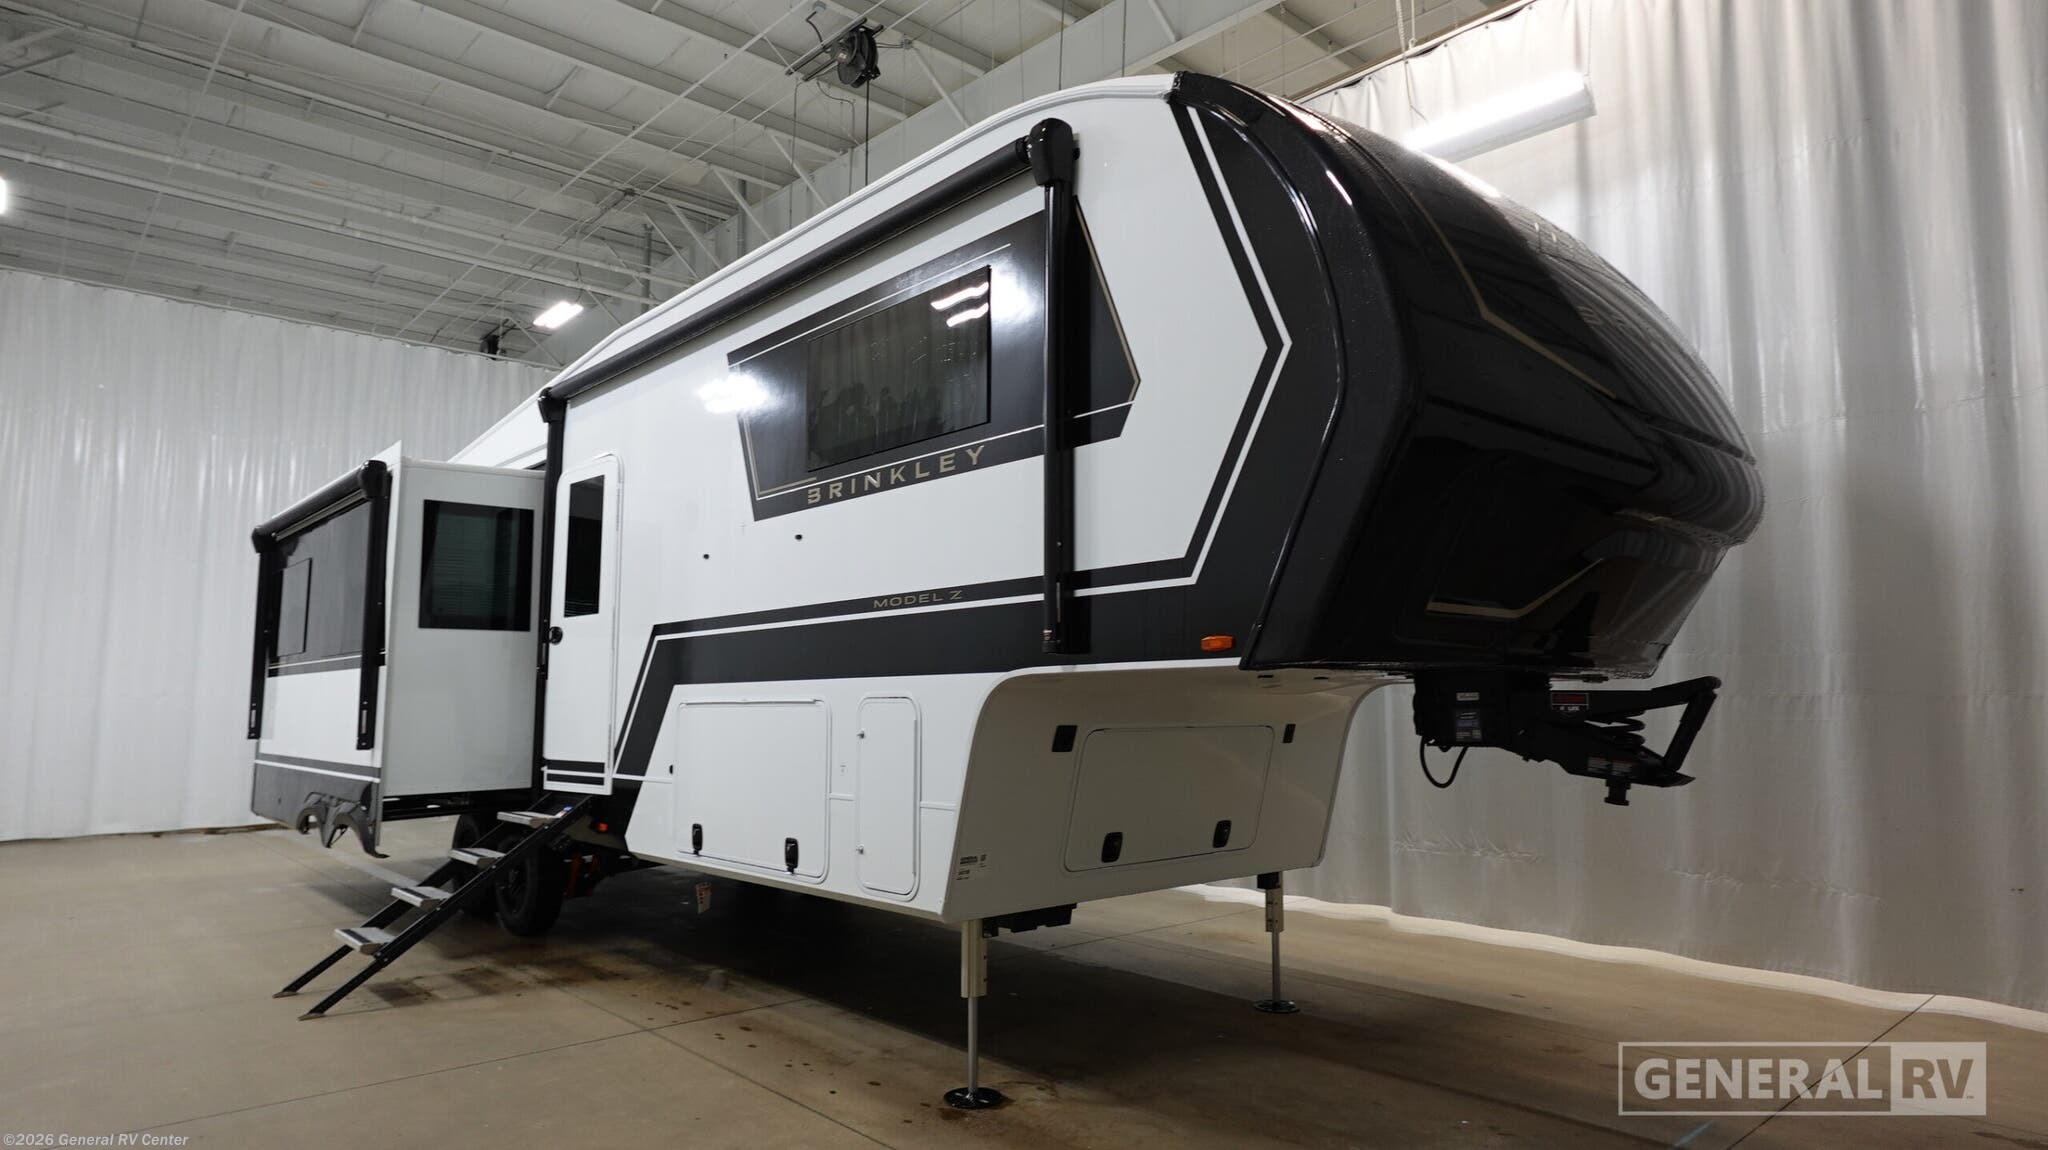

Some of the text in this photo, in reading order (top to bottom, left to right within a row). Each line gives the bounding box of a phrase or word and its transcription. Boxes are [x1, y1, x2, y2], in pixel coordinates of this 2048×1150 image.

[807, 445, 985, 505] BRINKLEY
[873, 590, 963, 609] MODEL Z
